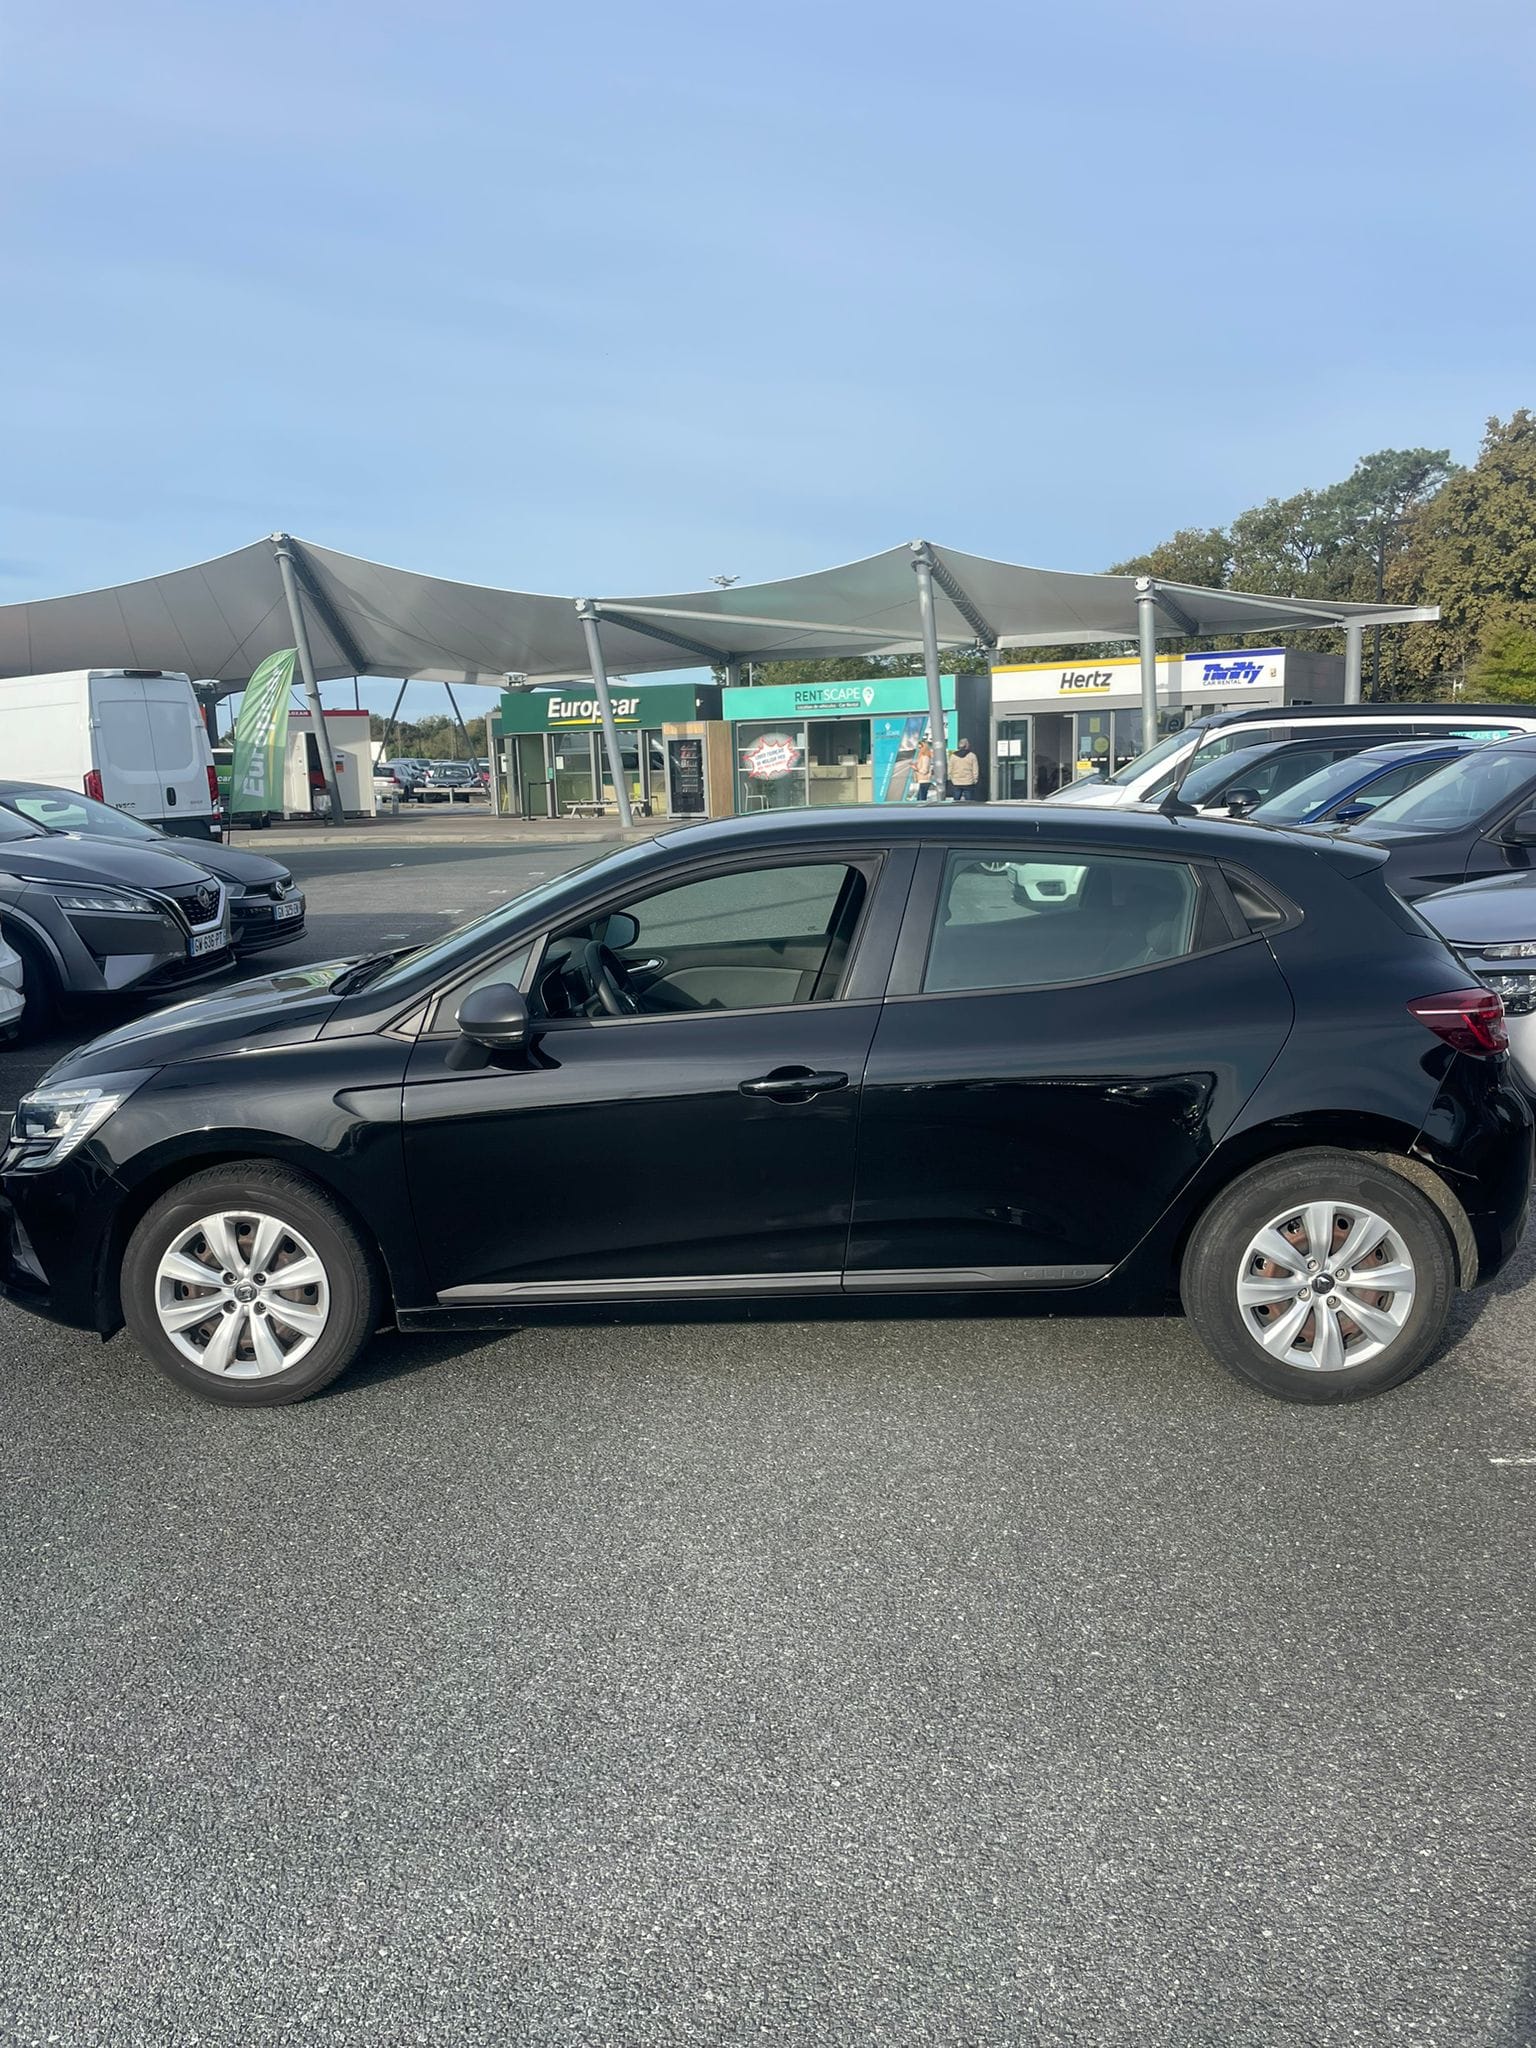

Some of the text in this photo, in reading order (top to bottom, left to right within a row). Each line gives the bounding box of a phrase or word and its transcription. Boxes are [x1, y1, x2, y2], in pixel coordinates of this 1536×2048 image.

[1060, 671, 1113, 689] Hertz
[794, 687, 861, 702] RENTSCAPE
[1023, 1267, 1087, 1280] CLIO
